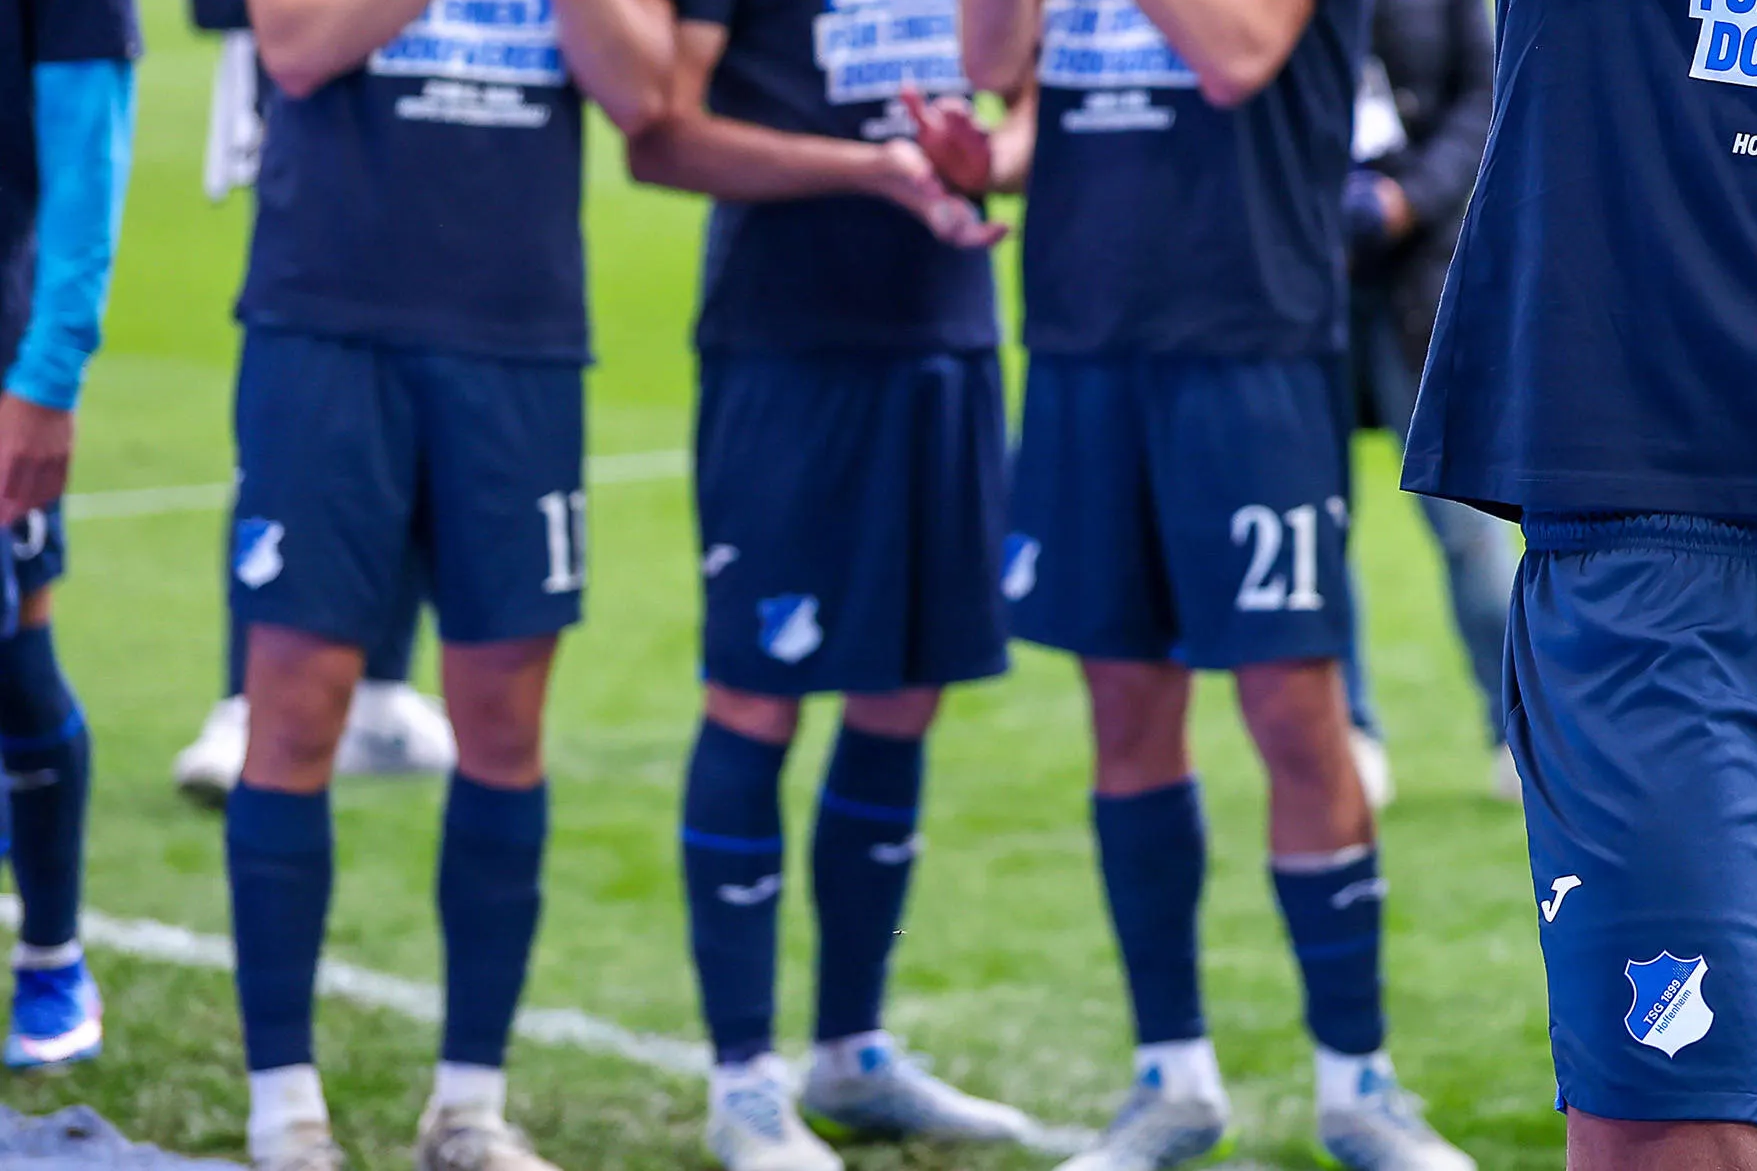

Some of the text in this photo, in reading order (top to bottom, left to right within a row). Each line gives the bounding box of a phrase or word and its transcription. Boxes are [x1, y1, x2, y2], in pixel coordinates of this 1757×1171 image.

[1231, 504, 1323, 612] 21
[1642, 978, 1681, 1026] TSG 1899
[1654, 988, 1693, 1035] Hoffenheim
